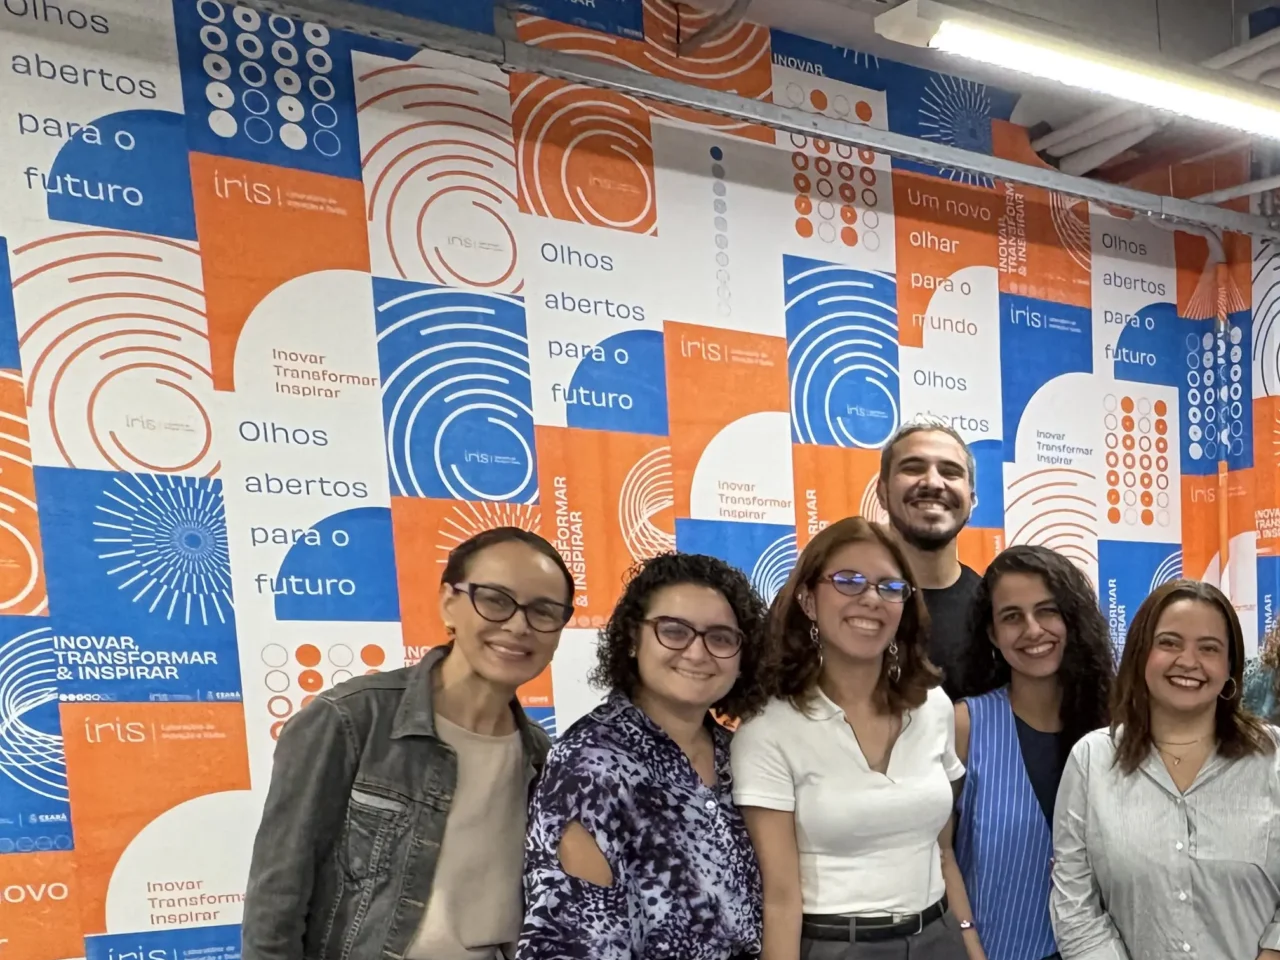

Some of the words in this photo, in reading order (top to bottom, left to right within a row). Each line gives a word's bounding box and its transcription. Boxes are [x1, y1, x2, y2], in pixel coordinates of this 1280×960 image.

[11, 53, 157, 100] abertos
[18, 113, 103, 145] para
[114, 130, 135, 151] o
[23, 166, 143, 206] futuro
[214, 170, 272, 206] iris
[907, 188, 939, 210] Um
[946, 198, 991, 221] novo
[909, 231, 959, 254] olhar
[1102, 232, 1147, 256] Olhos
[541, 242, 614, 271] Olhos
[911, 272, 954, 293] para
[960, 281, 971, 296] o
[1102, 272, 1166, 296] abertos
[545, 292, 645, 321] abertos
[1010, 304, 1042, 329] iris
[913, 312, 978, 336] mundo
[1104, 309, 1140, 329] para
[1145, 316, 1155, 331] o
[272, 348, 326, 365] Inovar
[548, 340, 605, 363] para
[614, 348, 629, 364] o
[680, 336, 721, 361] iris
[1105, 344, 1156, 366] futuro
[274, 365, 379, 387] Transformar
[913, 369, 967, 391] Olhos
[275, 382, 341, 399] Inspirar
[551, 384, 633, 410] futuro
[239, 420, 329, 447] Olhos
[244, 475, 369, 498] abertos
[250, 526, 322, 547] para
[331, 529, 350, 548] o
[570, 511, 587, 590] INSPIRAR
[254, 573, 356, 597] futuro
[575, 594, 589, 607] &
[54, 635, 140, 651] INOVAR,
[55, 651, 217, 665] TRANSFORMAR
[56, 667, 73, 680] &
[78, 666, 179, 680] INSPIRAR
[84, 718, 145, 744] iris
[146, 879, 203, 893] Inovar
[150, 909, 220, 926] Inspirar
